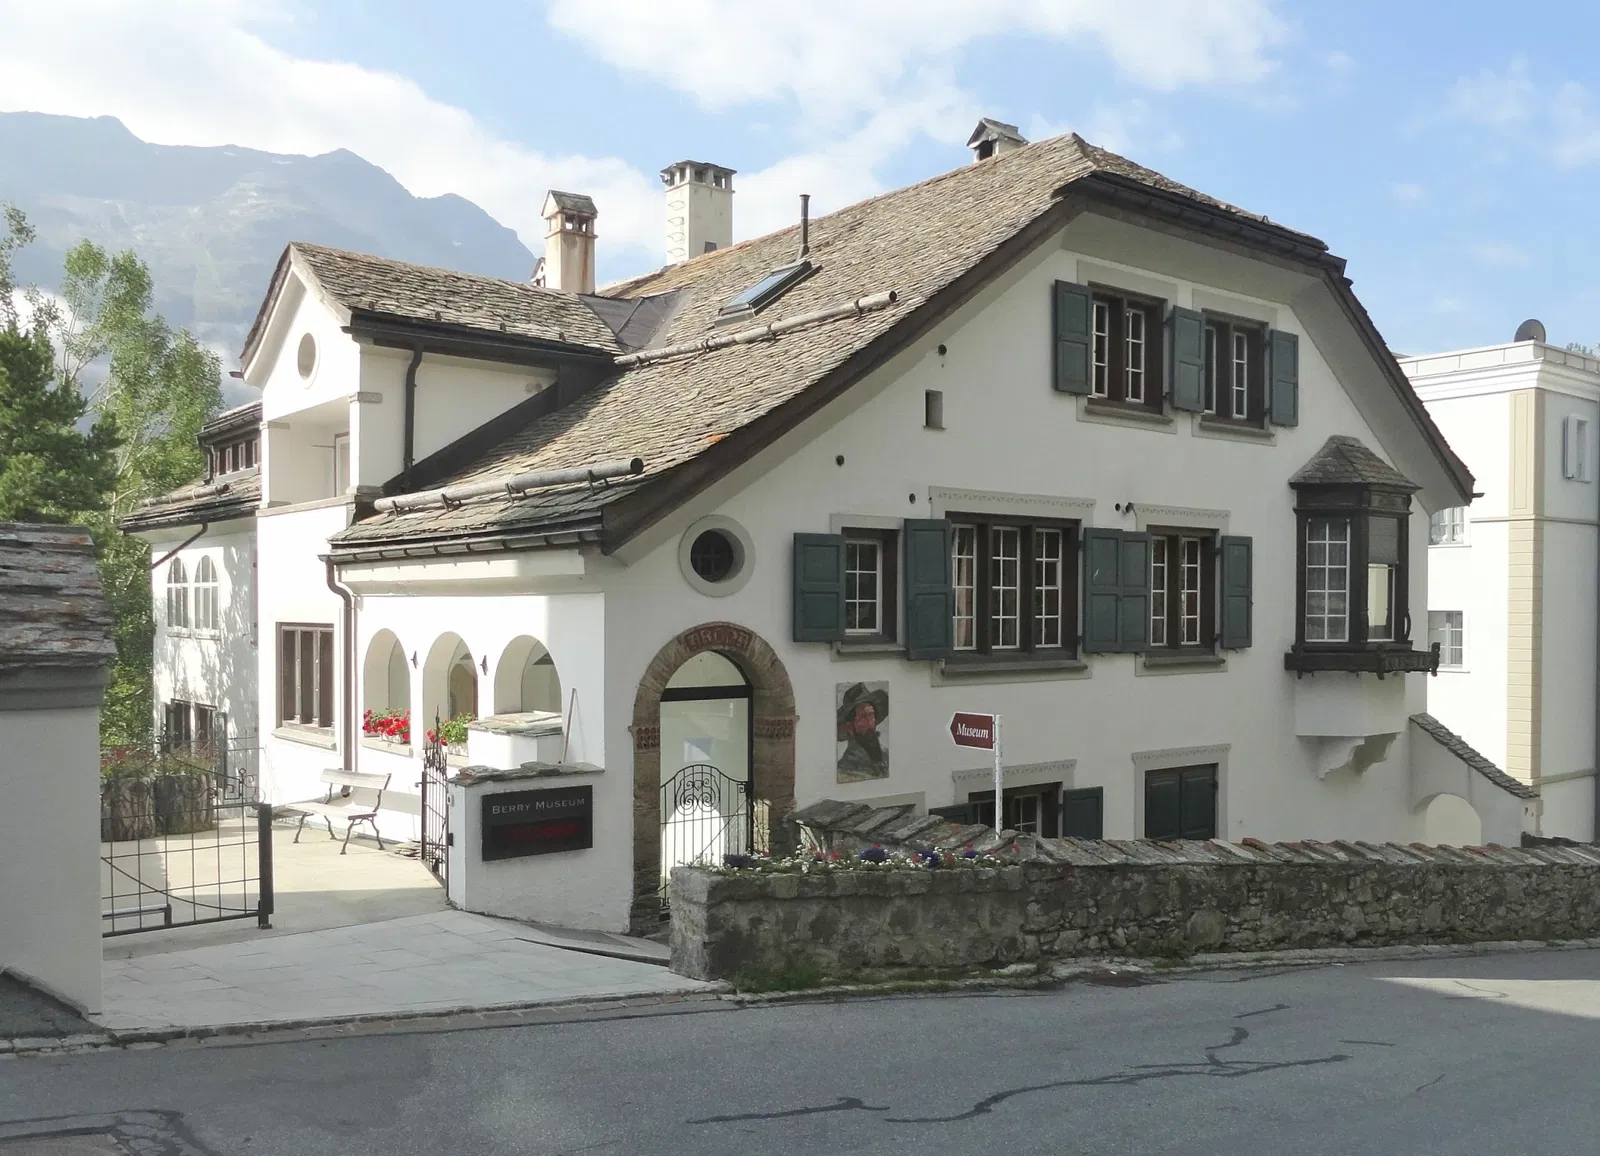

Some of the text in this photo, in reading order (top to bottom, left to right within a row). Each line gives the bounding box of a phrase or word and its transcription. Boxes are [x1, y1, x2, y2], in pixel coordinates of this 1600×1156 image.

[956, 722, 989, 739] Museum
[492, 798, 585, 815] BERRY MUSEUM
